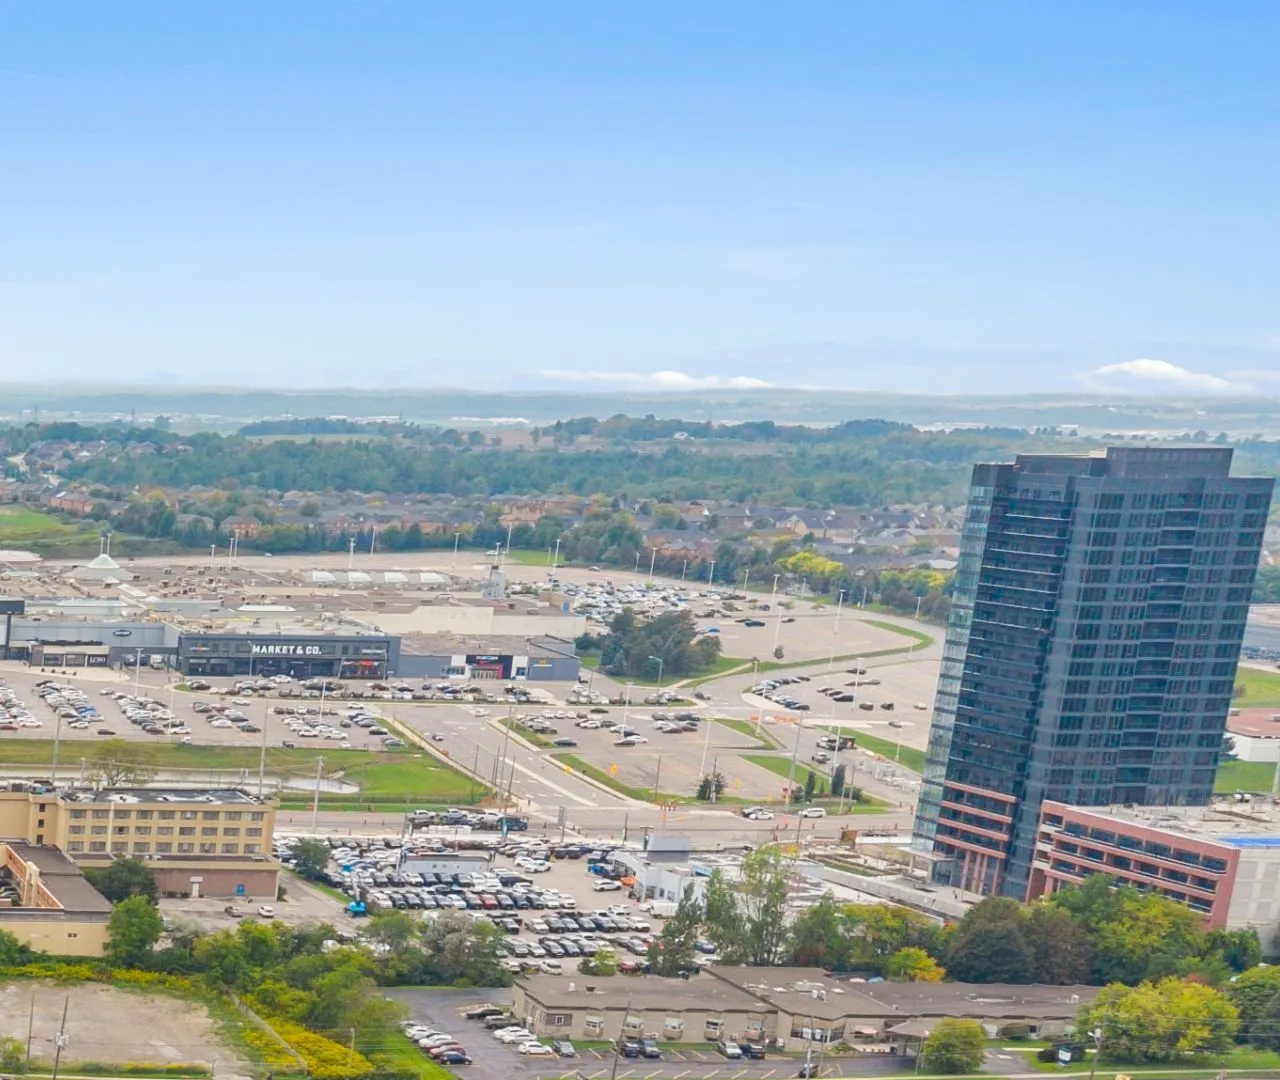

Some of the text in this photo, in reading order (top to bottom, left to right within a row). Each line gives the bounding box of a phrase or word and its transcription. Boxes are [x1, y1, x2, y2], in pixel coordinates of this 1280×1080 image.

[252, 645, 322, 655] MARKET & CO.
